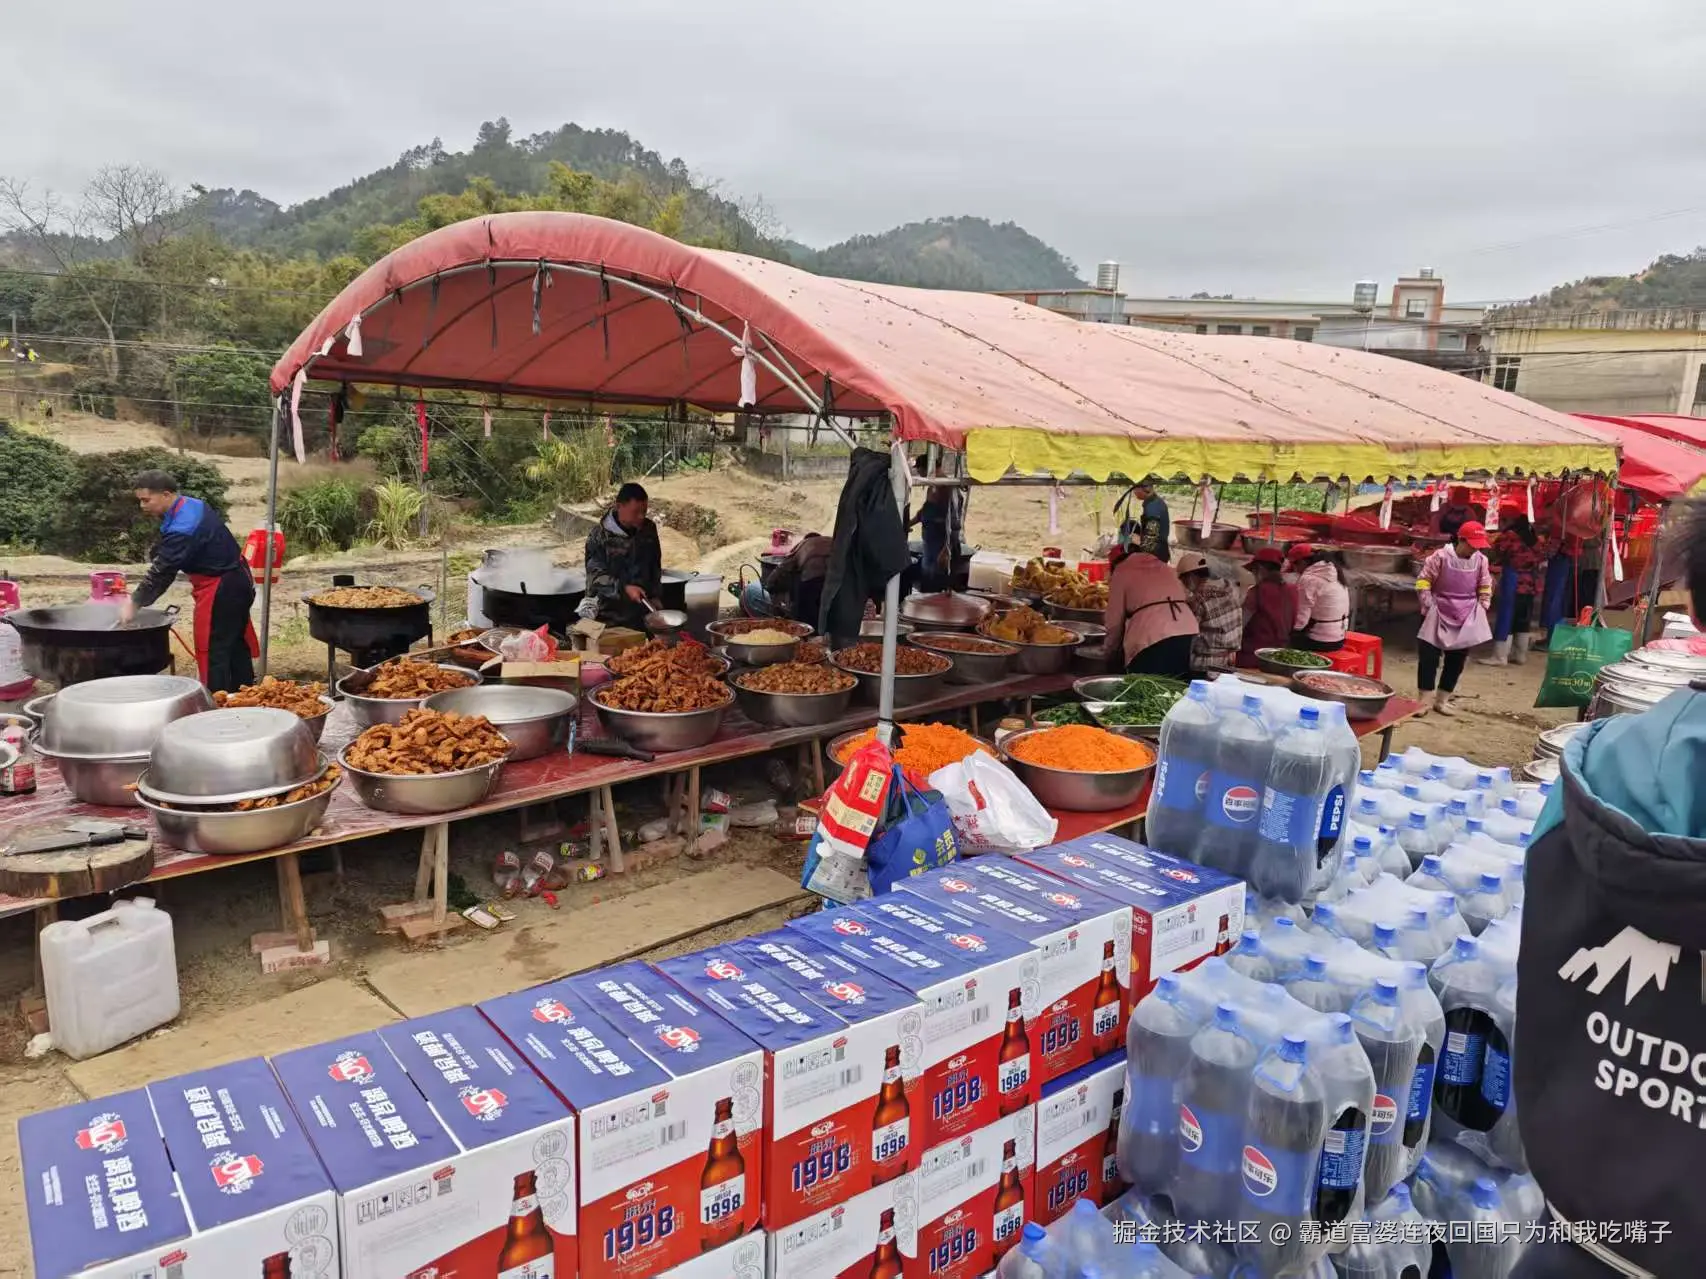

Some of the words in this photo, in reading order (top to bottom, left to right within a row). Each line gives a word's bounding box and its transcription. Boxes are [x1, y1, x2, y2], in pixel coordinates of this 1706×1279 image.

[1330, 794, 1344, 831] PEPSI
[1041, 1017, 1080, 1057] 1998
[1096, 1014, 1118, 1035] 1998
[933, 1075, 982, 1120] 1998
[1001, 1069, 1027, 1093] 1998
[360, 1085, 419, 1150] 漓泉啤酒
[791, 1142, 852, 1193] 1998
[875, 1134, 906, 1160] 1998
[102, 1155, 150, 1232] 漓泉啤酒
[704, 1193, 741, 1222] 1998
[1047, 1169, 1089, 1212] 1998
[603, 1204, 675, 1262] 1998
[996, 1216, 1021, 1240] 1998
[929, 1227, 977, 1276] 1998
